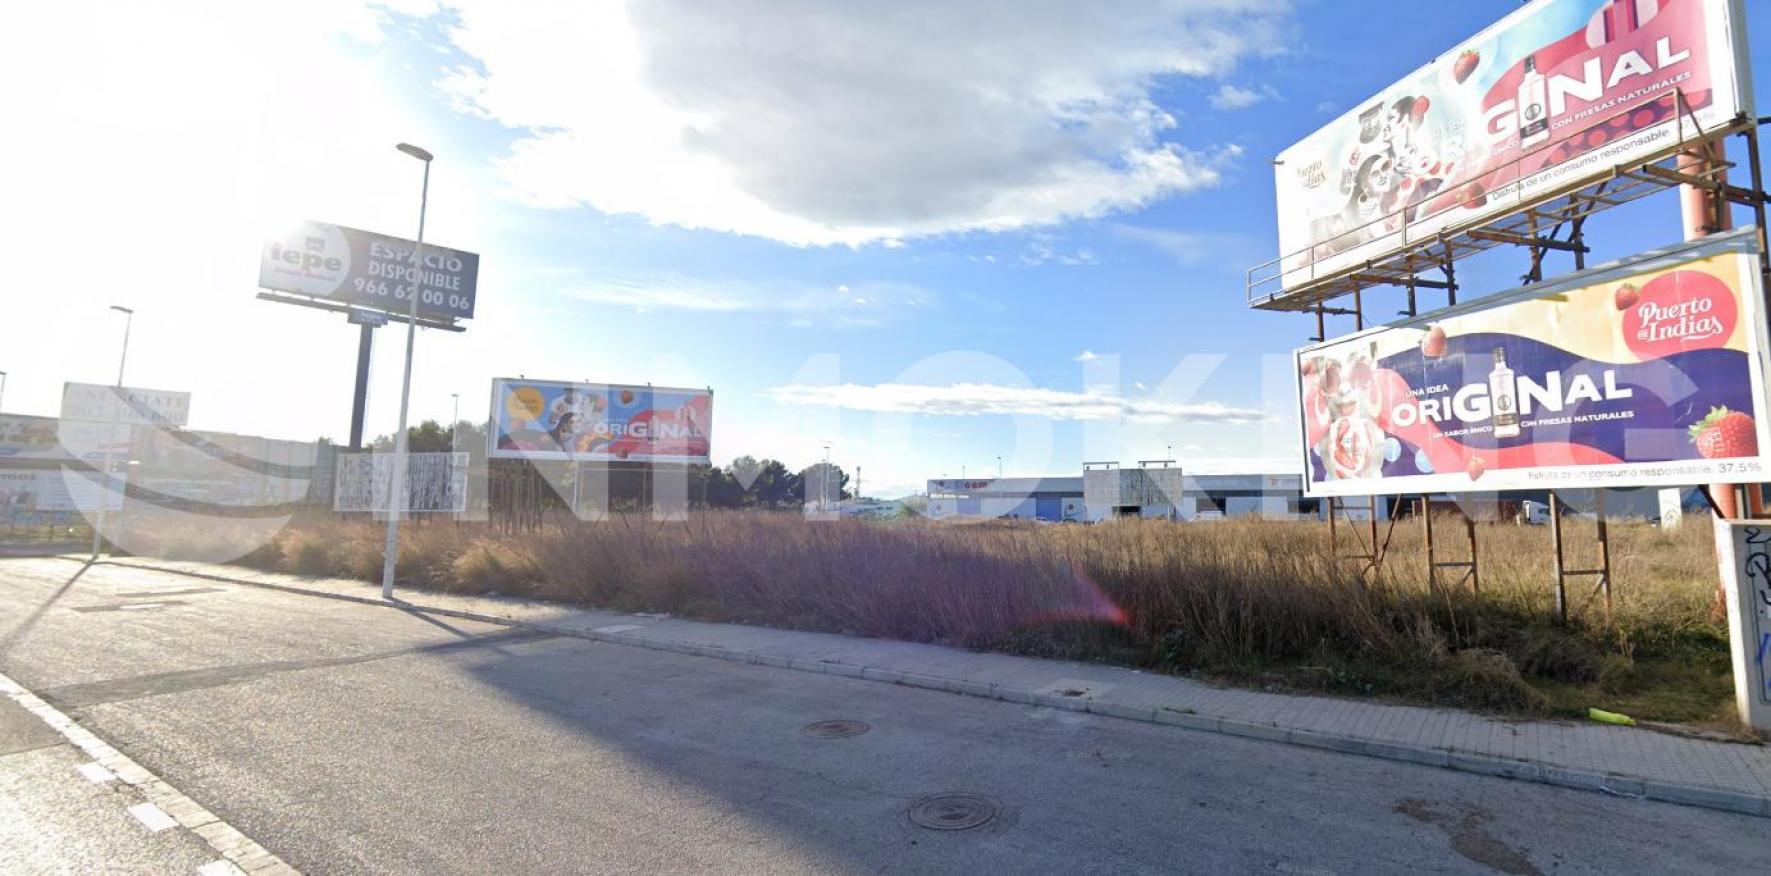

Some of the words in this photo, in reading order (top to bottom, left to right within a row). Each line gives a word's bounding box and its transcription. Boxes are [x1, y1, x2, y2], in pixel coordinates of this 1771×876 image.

[1551, 115, 1573, 131] CON
[1574, 100, 1616, 121] FRESAS
[1618, 71, 1692, 104] NATURALES
[1526, 176, 1538, 188] de
[1539, 172, 1553, 183] un
[1553, 153, 1598, 178] consumo
[370, 242, 463, 272] ESPACIO
[368, 260, 461, 290] DISPONIBLE
[354, 277, 388, 296] 966
[422, 289, 444, 306] 00
[448, 294, 470, 310] 06
[1638, 297, 1712, 328] Puerto
[1647, 315, 1724, 342] Indias
[1392, 368, 1633, 428] ORIGINAL
[1405, 388, 1425, 399] UNA
[1427, 383, 1449, 395] IDEA
[1539, 416, 1572, 426] FRESAS
[1574, 410, 1635, 423] NATURALES
